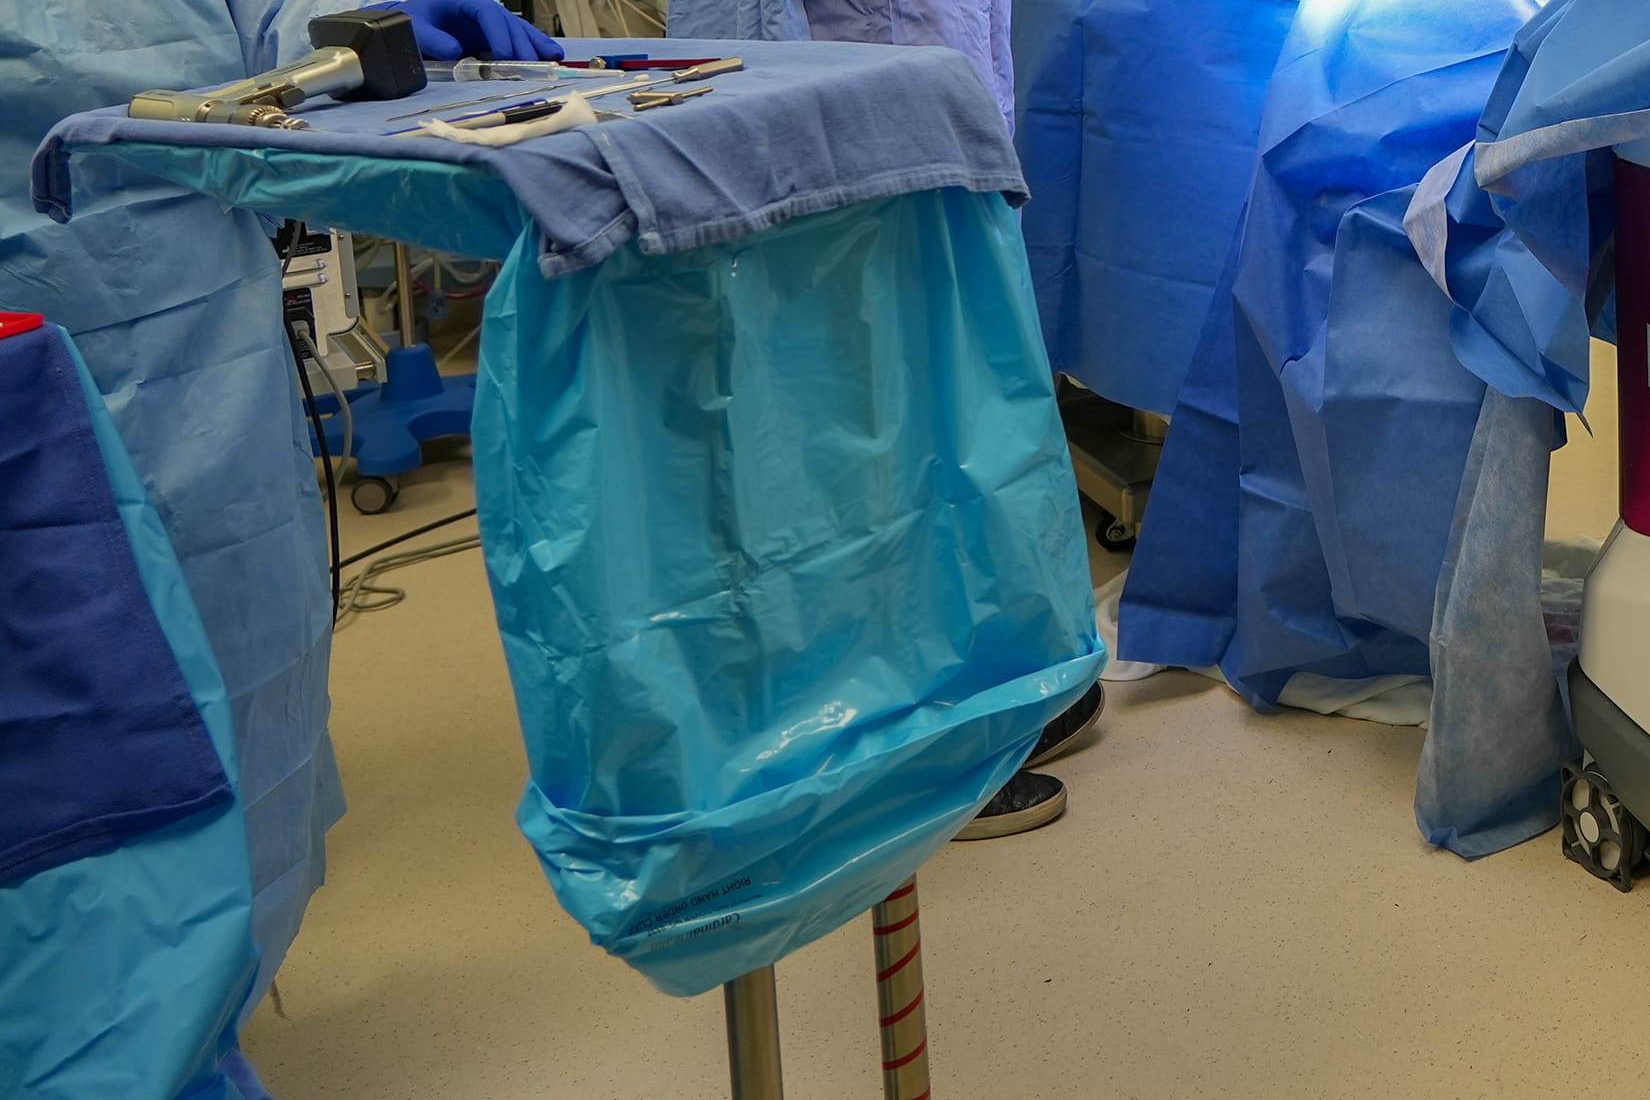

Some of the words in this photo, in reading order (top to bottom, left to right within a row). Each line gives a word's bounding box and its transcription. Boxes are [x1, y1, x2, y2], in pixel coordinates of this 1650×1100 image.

[722, 876, 751, 895] RIGHT
[690, 891, 720, 906] HAND
[655, 902, 689, 922] UNDER
